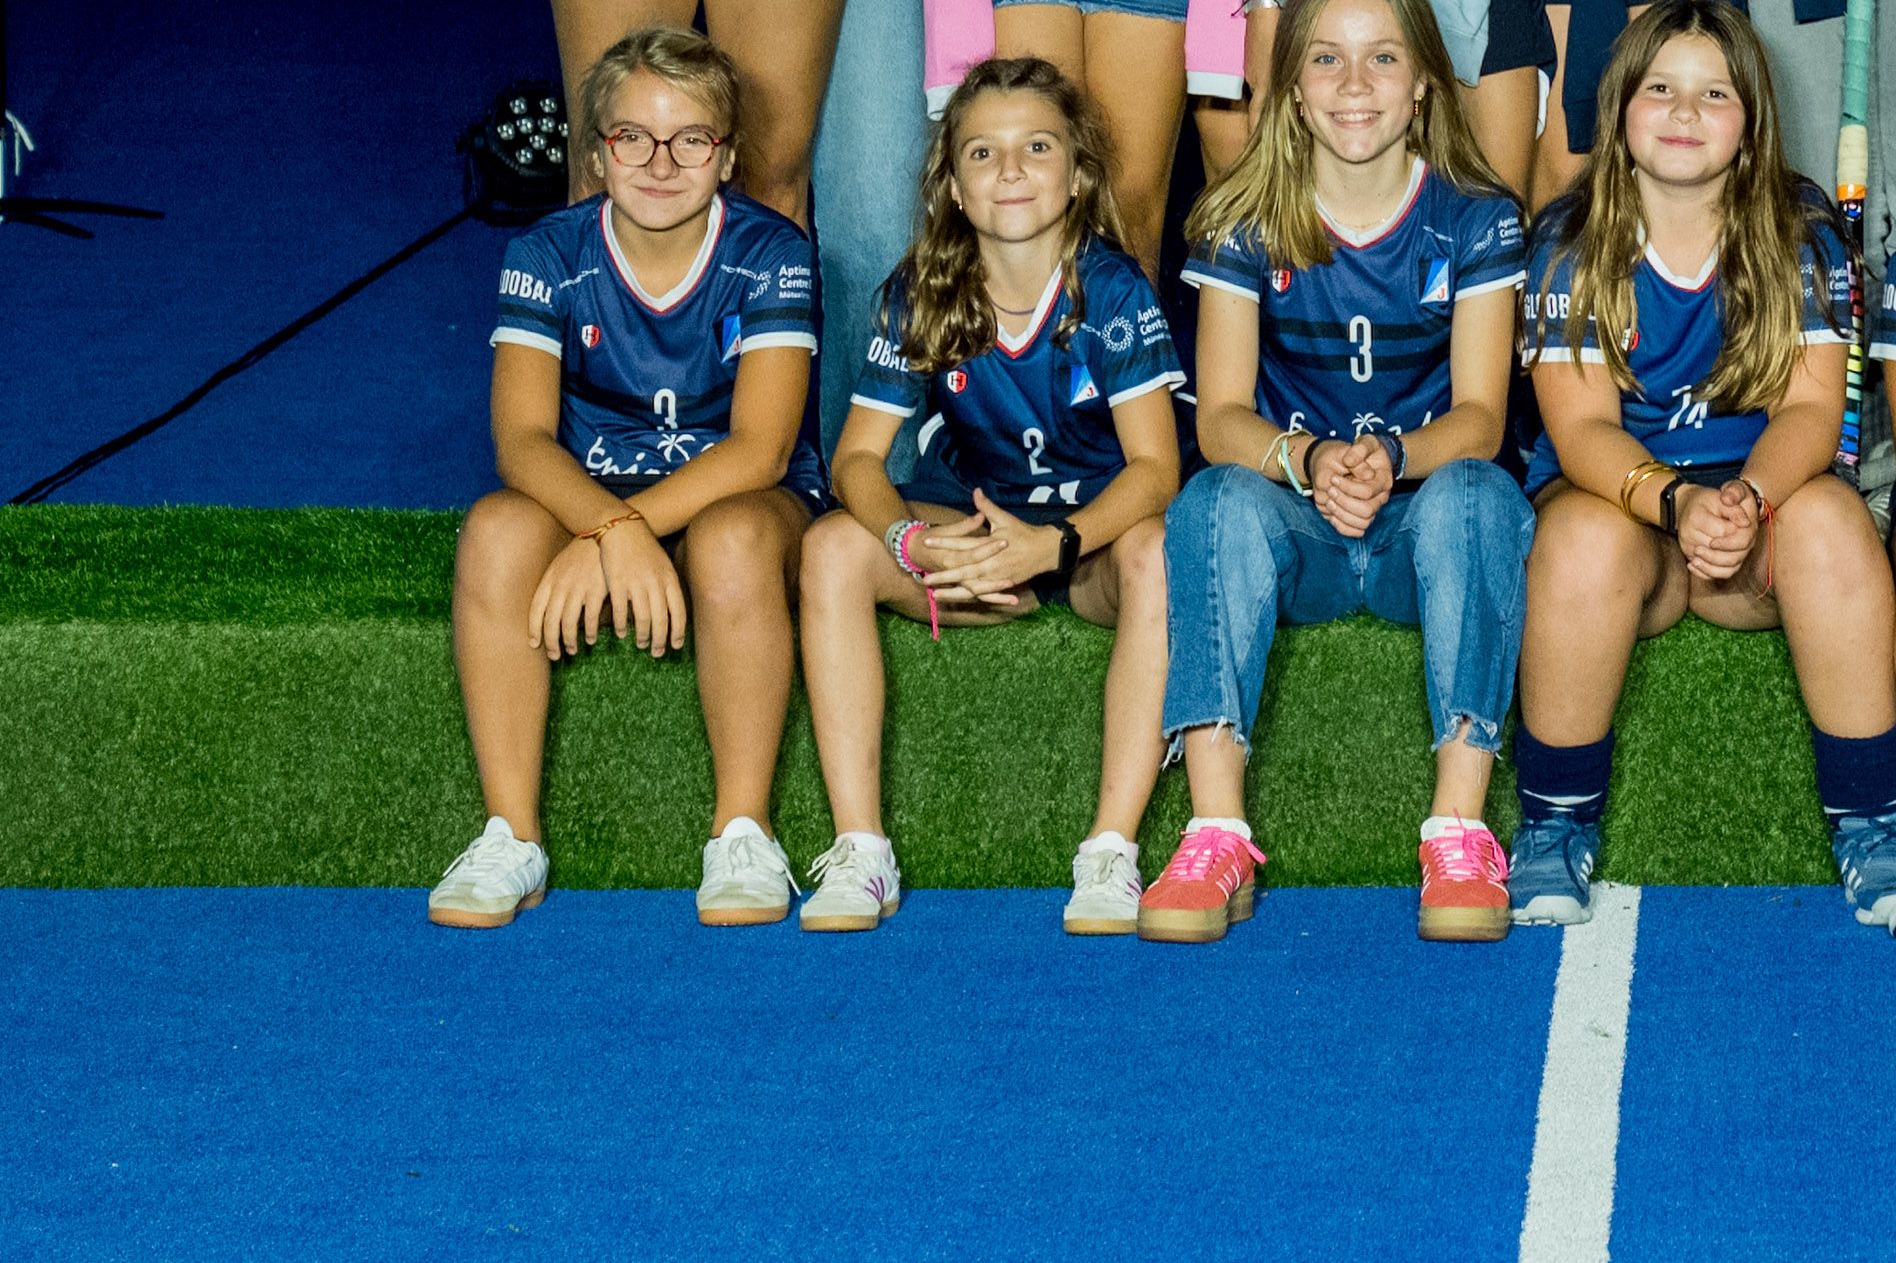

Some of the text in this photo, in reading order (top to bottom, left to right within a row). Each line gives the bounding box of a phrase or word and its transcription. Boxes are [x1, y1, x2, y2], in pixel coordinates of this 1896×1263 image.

[866, 336, 908, 372] OBAL
[1349, 314, 1374, 383] 3
[1022, 427, 1053, 475] 2
